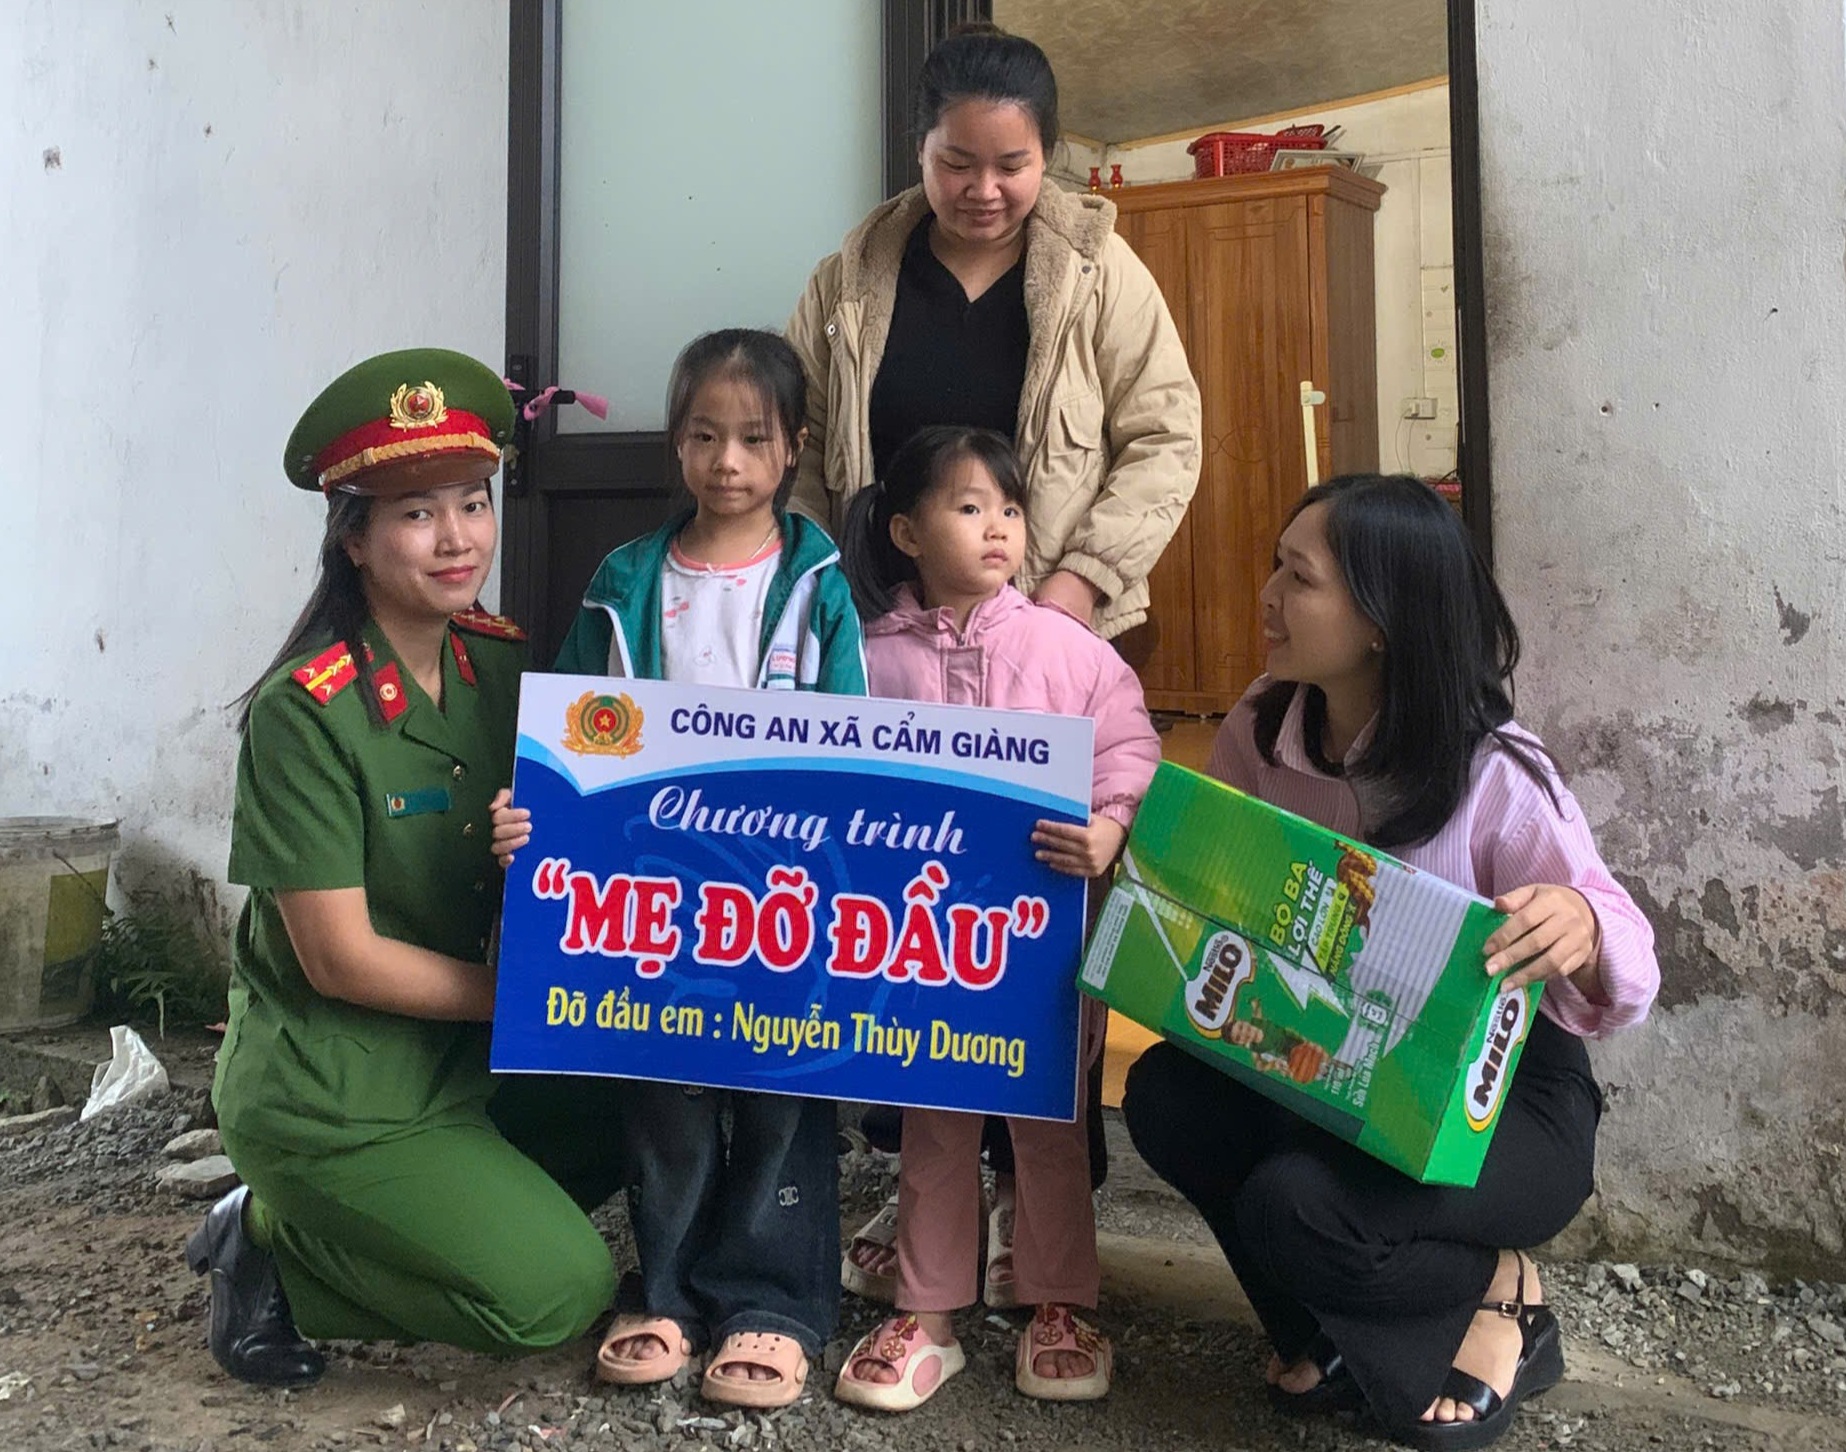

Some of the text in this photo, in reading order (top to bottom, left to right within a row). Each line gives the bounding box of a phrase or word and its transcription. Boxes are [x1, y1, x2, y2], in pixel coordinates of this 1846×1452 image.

[671, 703, 1050, 764] CÔNG AN XÃ CẨM GIÀNG
[648, 785, 967, 855] Chương trình
[694, 866, 818, 971] ĐỠ
[1268, 862, 1308, 947] BỘ BA
[1288, 859, 1324, 957] LỢI THẾ
[1194, 943, 1243, 1022] MILO
[596, 985, 651, 1031] đầu
[660, 1005, 704, 1037] em
[731, 1001, 841, 1057] Nguyễn
[850, 1012, 921, 1068] Thùy
[929, 1019, 1026, 1078] Dương
[1473, 998, 1520, 1108] MILO
